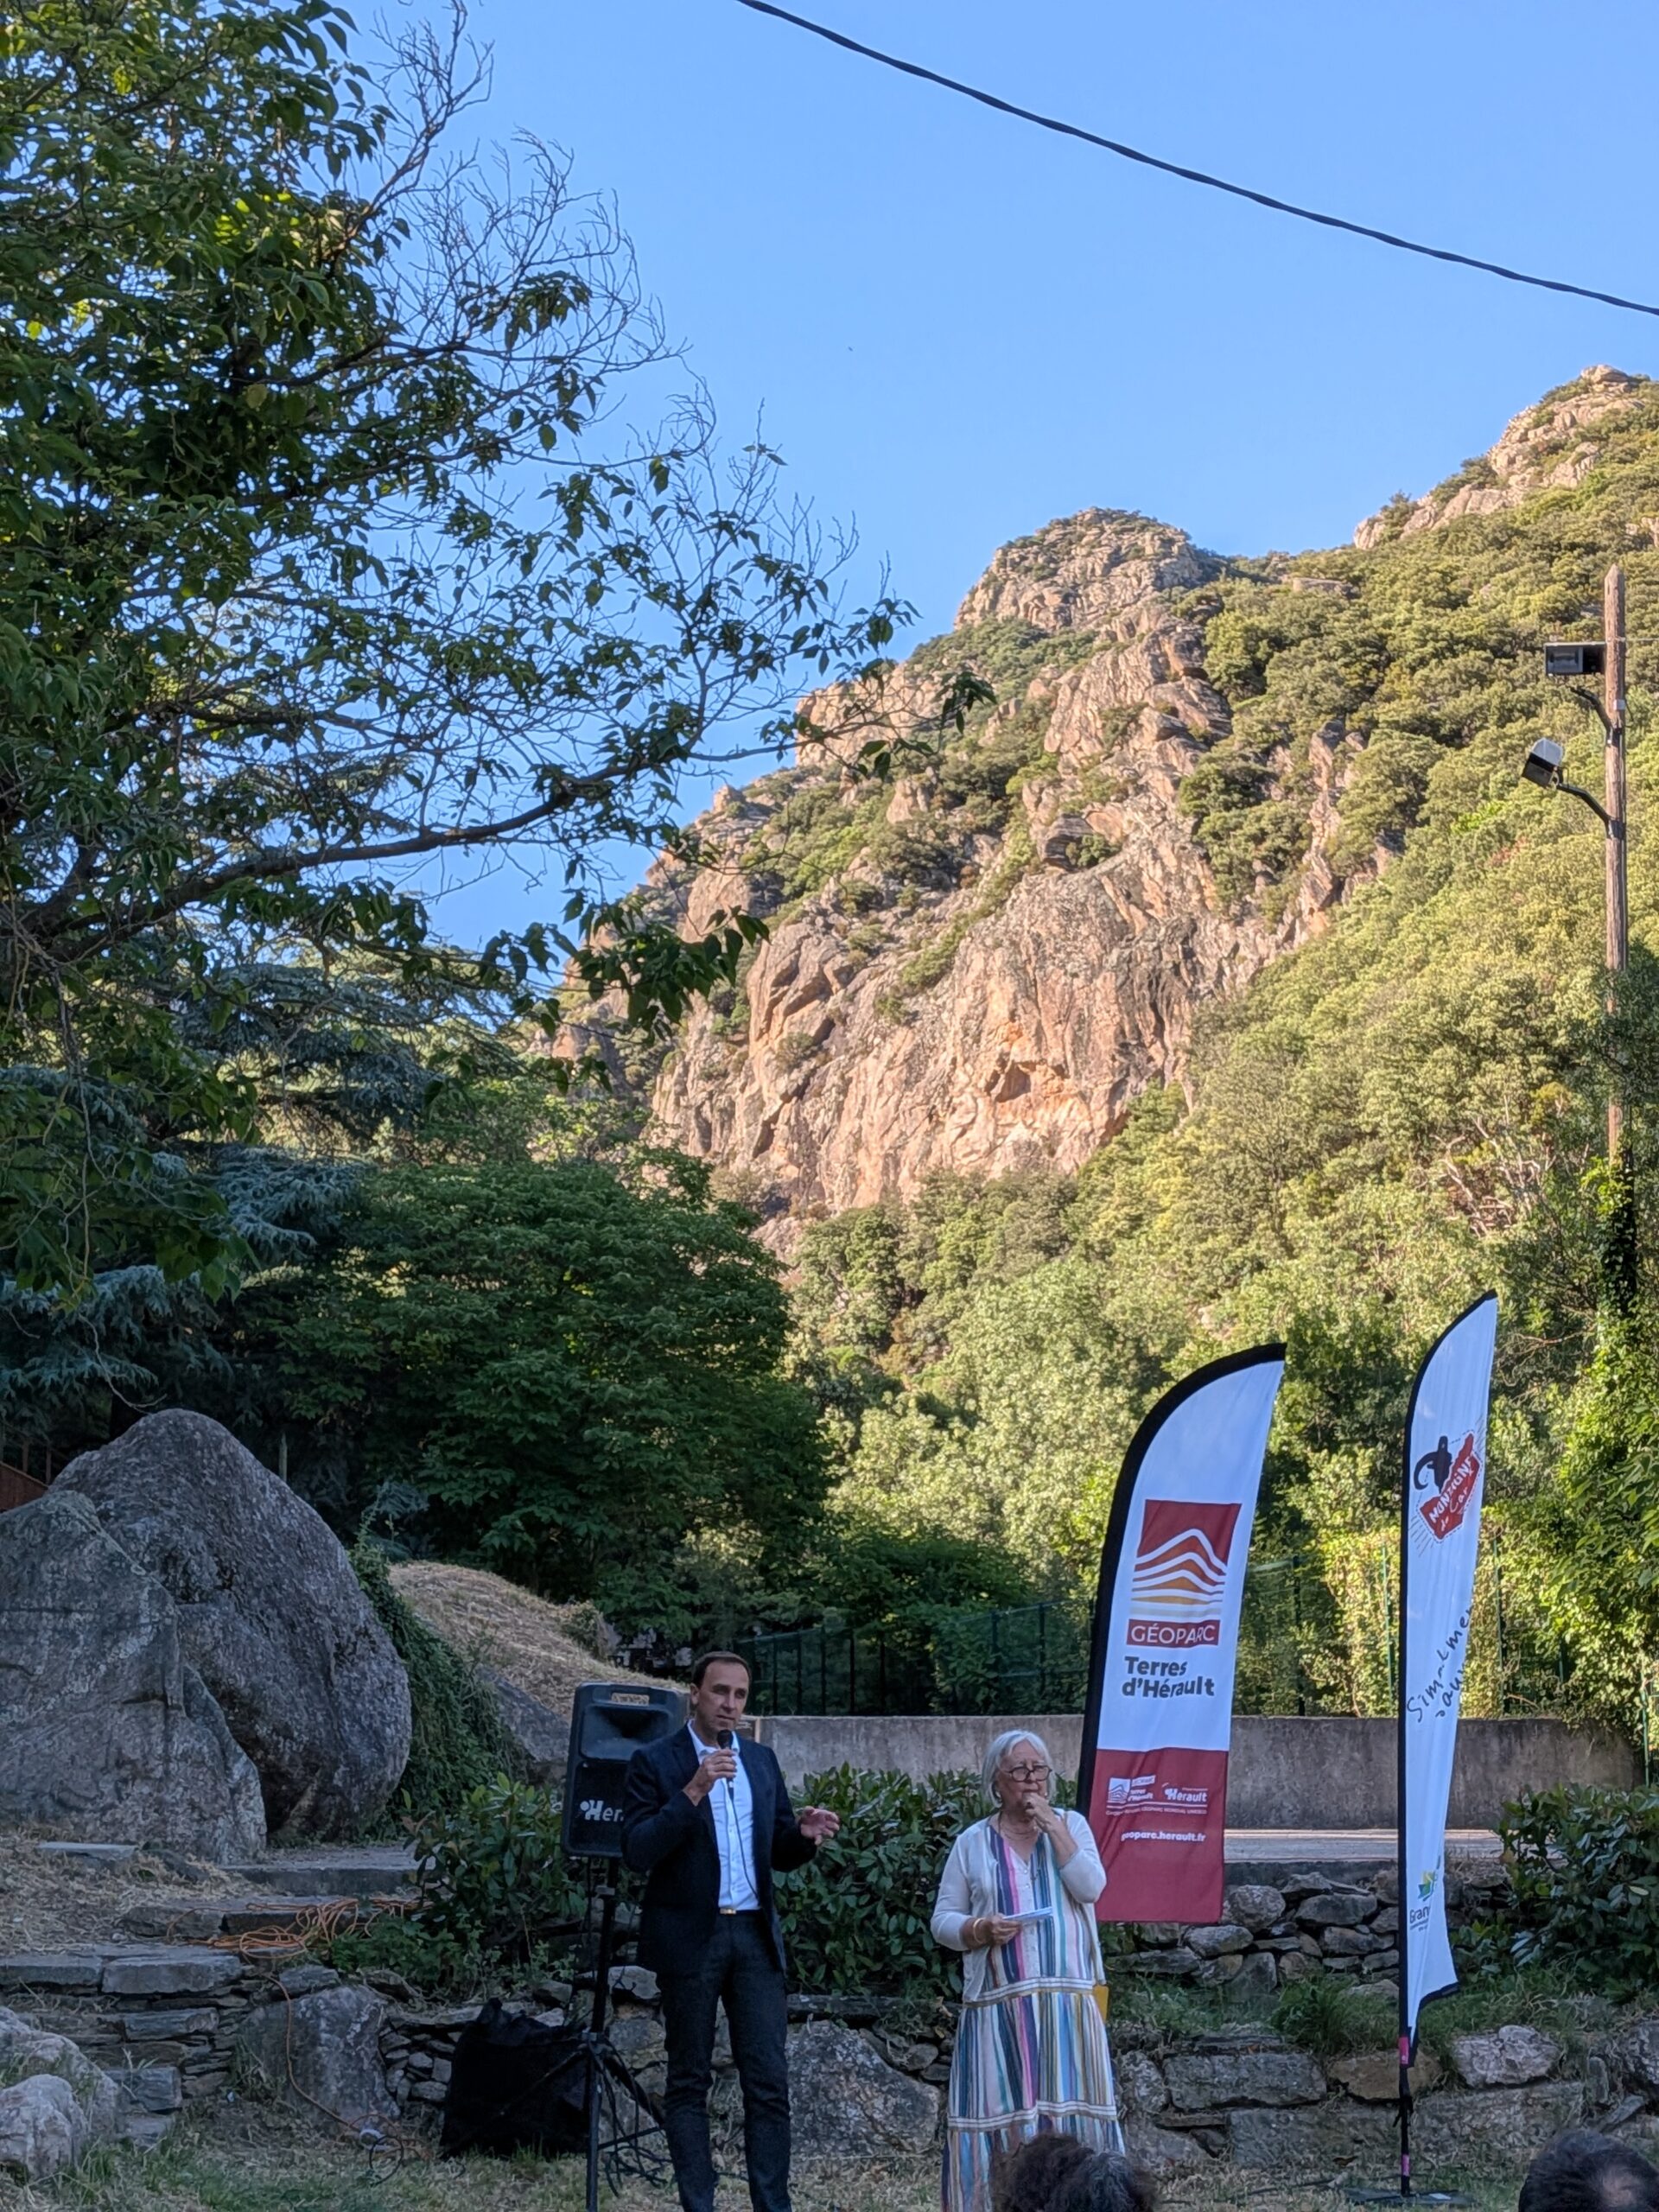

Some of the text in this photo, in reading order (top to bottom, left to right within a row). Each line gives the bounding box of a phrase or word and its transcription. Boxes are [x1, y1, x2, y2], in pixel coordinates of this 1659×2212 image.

[1130, 1623, 1216, 1645] GÉOPARC
[1124, 1656, 1188, 1677] Terres
[1122, 1675, 1215, 1699] d'Hérault
[583, 1799, 625, 1822] Her
[1120, 1830, 1207, 1842] geoparc.herault.fr
